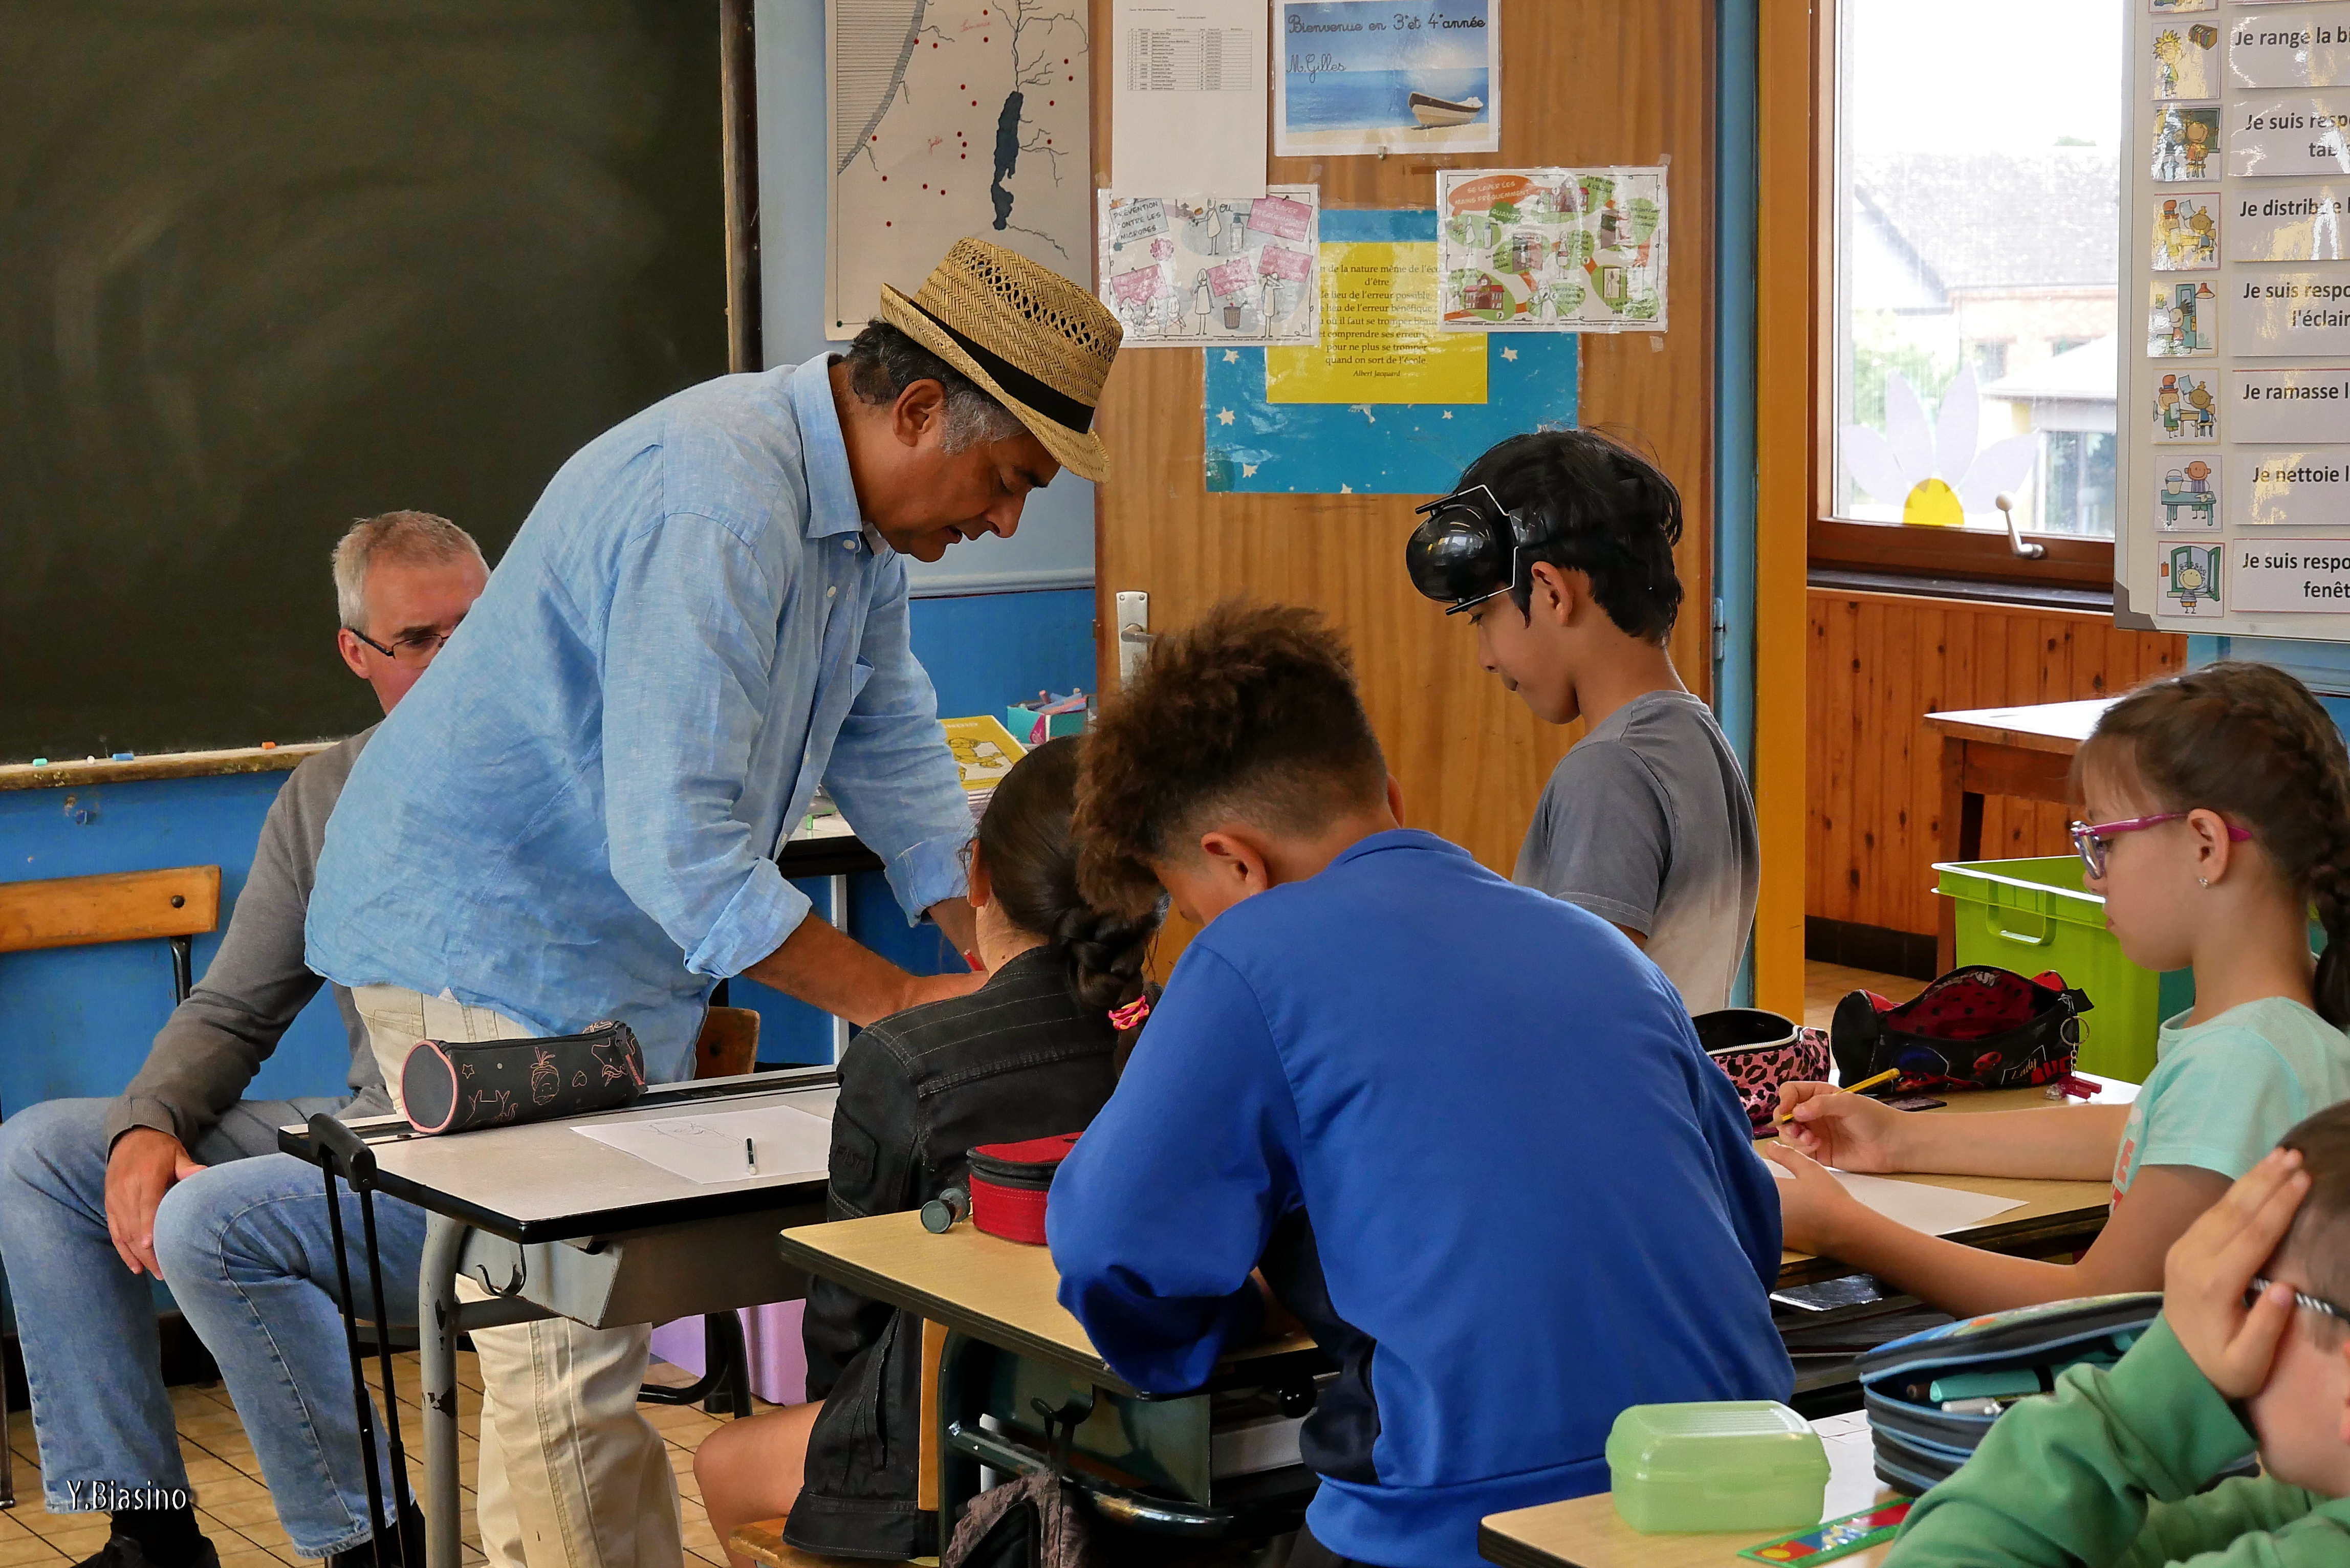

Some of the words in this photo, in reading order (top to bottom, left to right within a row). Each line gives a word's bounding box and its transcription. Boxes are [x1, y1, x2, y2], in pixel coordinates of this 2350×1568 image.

[1288, 14, 1363, 34] Bienvenue
[1368, 23, 1386, 32] en
[1443, 16, 1486, 29] année
[2235, 32, 2253, 46] Je
[2260, 31, 2311, 49] range
[2317, 27, 2331, 43] la
[2245, 115, 2264, 130] Je
[2270, 113, 2303, 129] suis
[2310, 115, 2350, 131] resp
[2240, 201, 2257, 216] Je
[2263, 198, 2342, 216] distribe
[1147, 212, 1161, 221] LES
[1381, 265, 1406, 273] même
[1364, 277, 1389, 286] d'être
[2244, 282, 2260, 298] Je
[2266, 282, 2299, 298] suis
[1344, 303, 1355, 312] de
[1357, 303, 1389, 312] l'erreur
[1378, 318, 1412, 327] tromper
[1328, 330, 1380, 340] comprendre
[1327, 344, 1347, 353] pour
[1362, 343, 1380, 353] plus
[1325, 356, 1353, 366] quand
[1374, 370, 1401, 378] Jacquard
[2243, 384, 2260, 400] Je
[2266, 386, 2339, 399] ramasse
[2345, 382, 2350, 399] l
[2253, 467, 2270, 483] Je
[2276, 466, 2339, 482] nettoie
[2243, 553, 2259, 568] Je
[2265, 553, 2297, 569] suis
[2011, 1058, 2038, 1080] Lady
[2031, 1055, 2073, 1084] BUG
